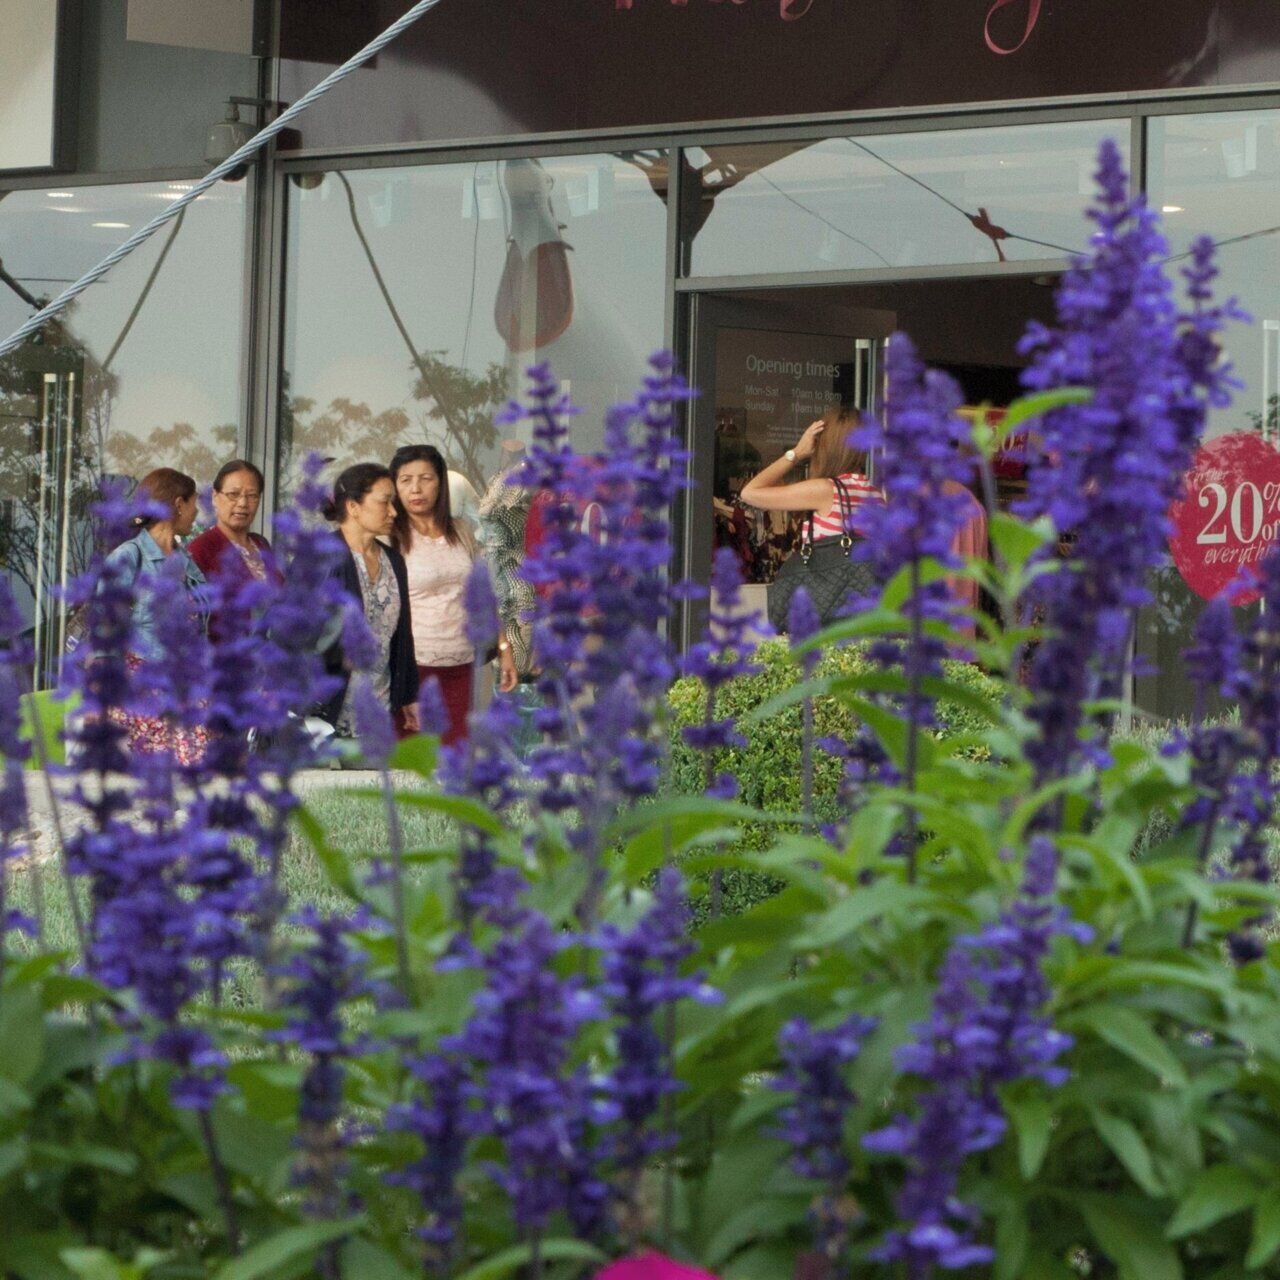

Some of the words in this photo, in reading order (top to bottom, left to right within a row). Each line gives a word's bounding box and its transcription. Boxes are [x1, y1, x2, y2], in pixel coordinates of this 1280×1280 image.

[746, 354, 802, 379] Opening
[806, 359, 840, 378] times
[744, 384, 780, 397] Mon-Sat
[792, 389, 813, 401] 10am
[814, 390, 823, 401] to
[744, 399, 776, 413] Sunday
[814, 404, 823, 414] to
